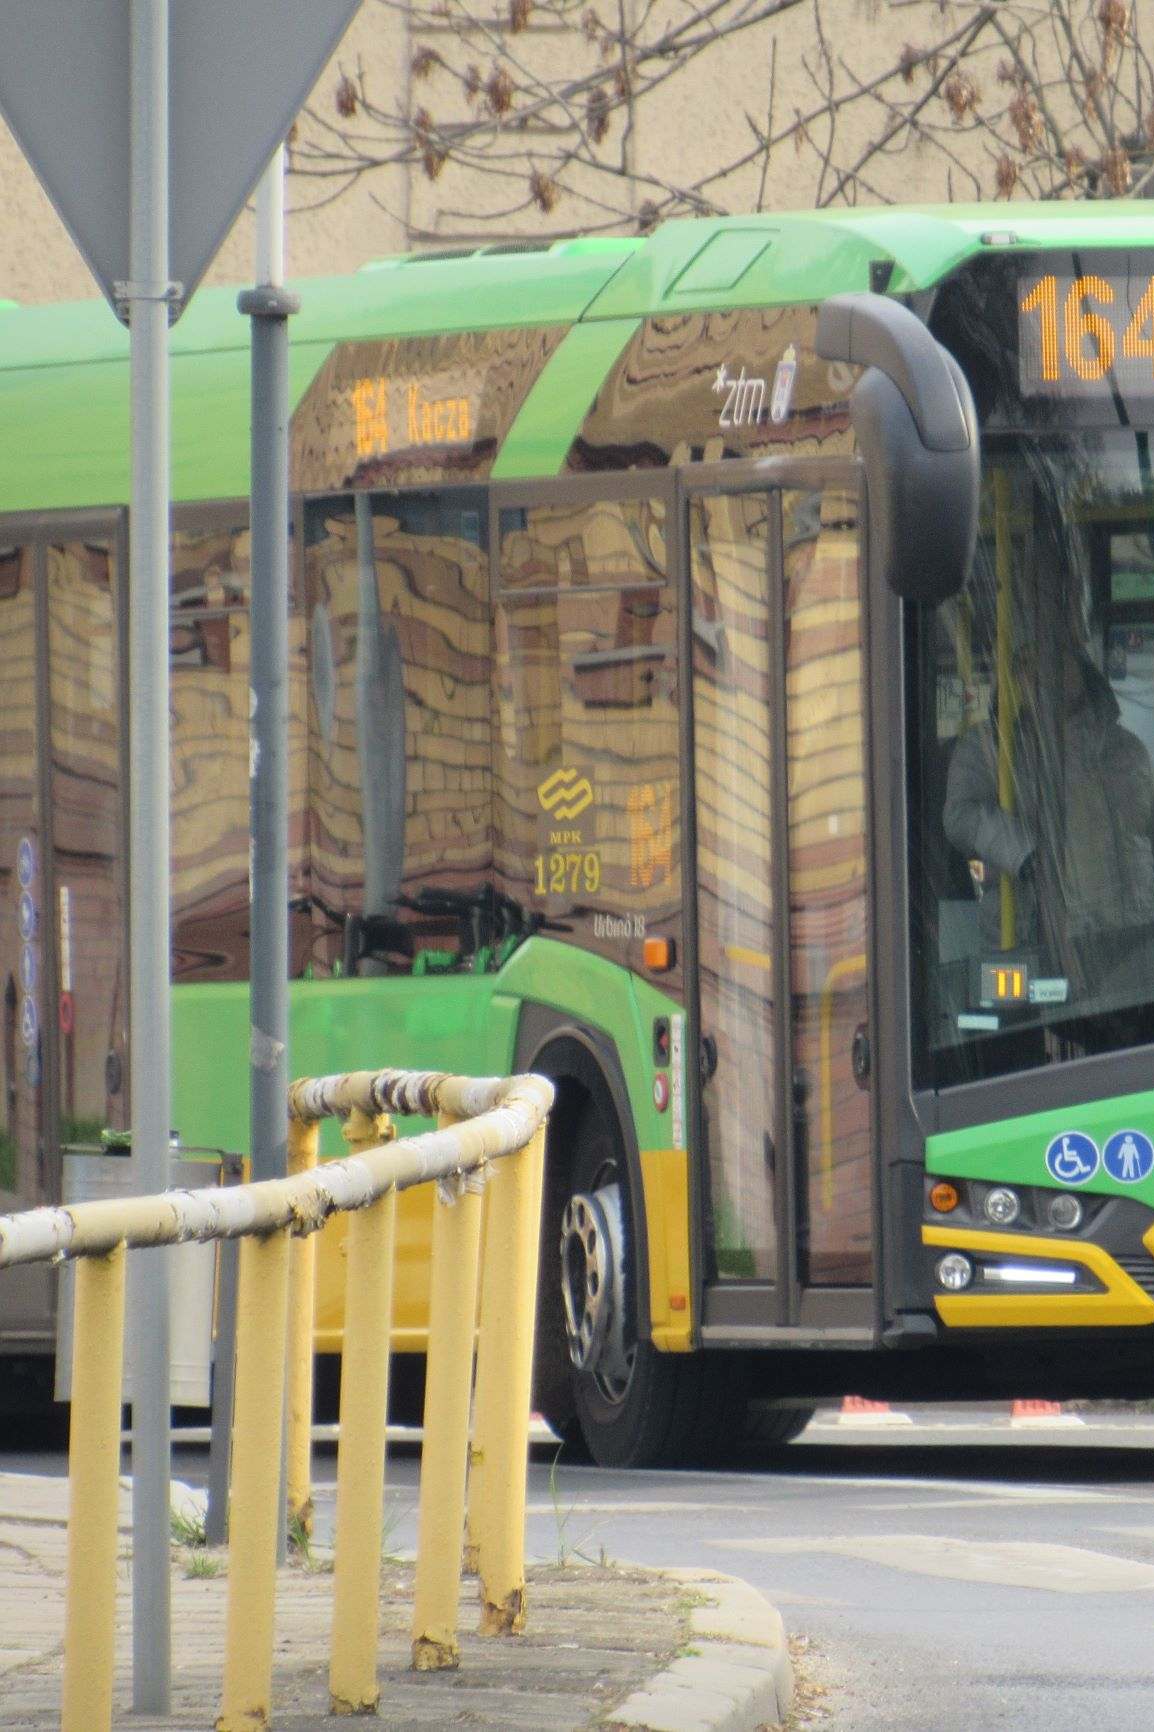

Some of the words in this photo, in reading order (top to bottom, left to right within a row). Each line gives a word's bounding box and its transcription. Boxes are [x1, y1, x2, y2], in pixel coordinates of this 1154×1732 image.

[351, 377, 388, 454] 164
[407, 383, 470, 442] Kacza
[550, 831, 582, 844] MPK
[534, 853, 600, 895] 1279
